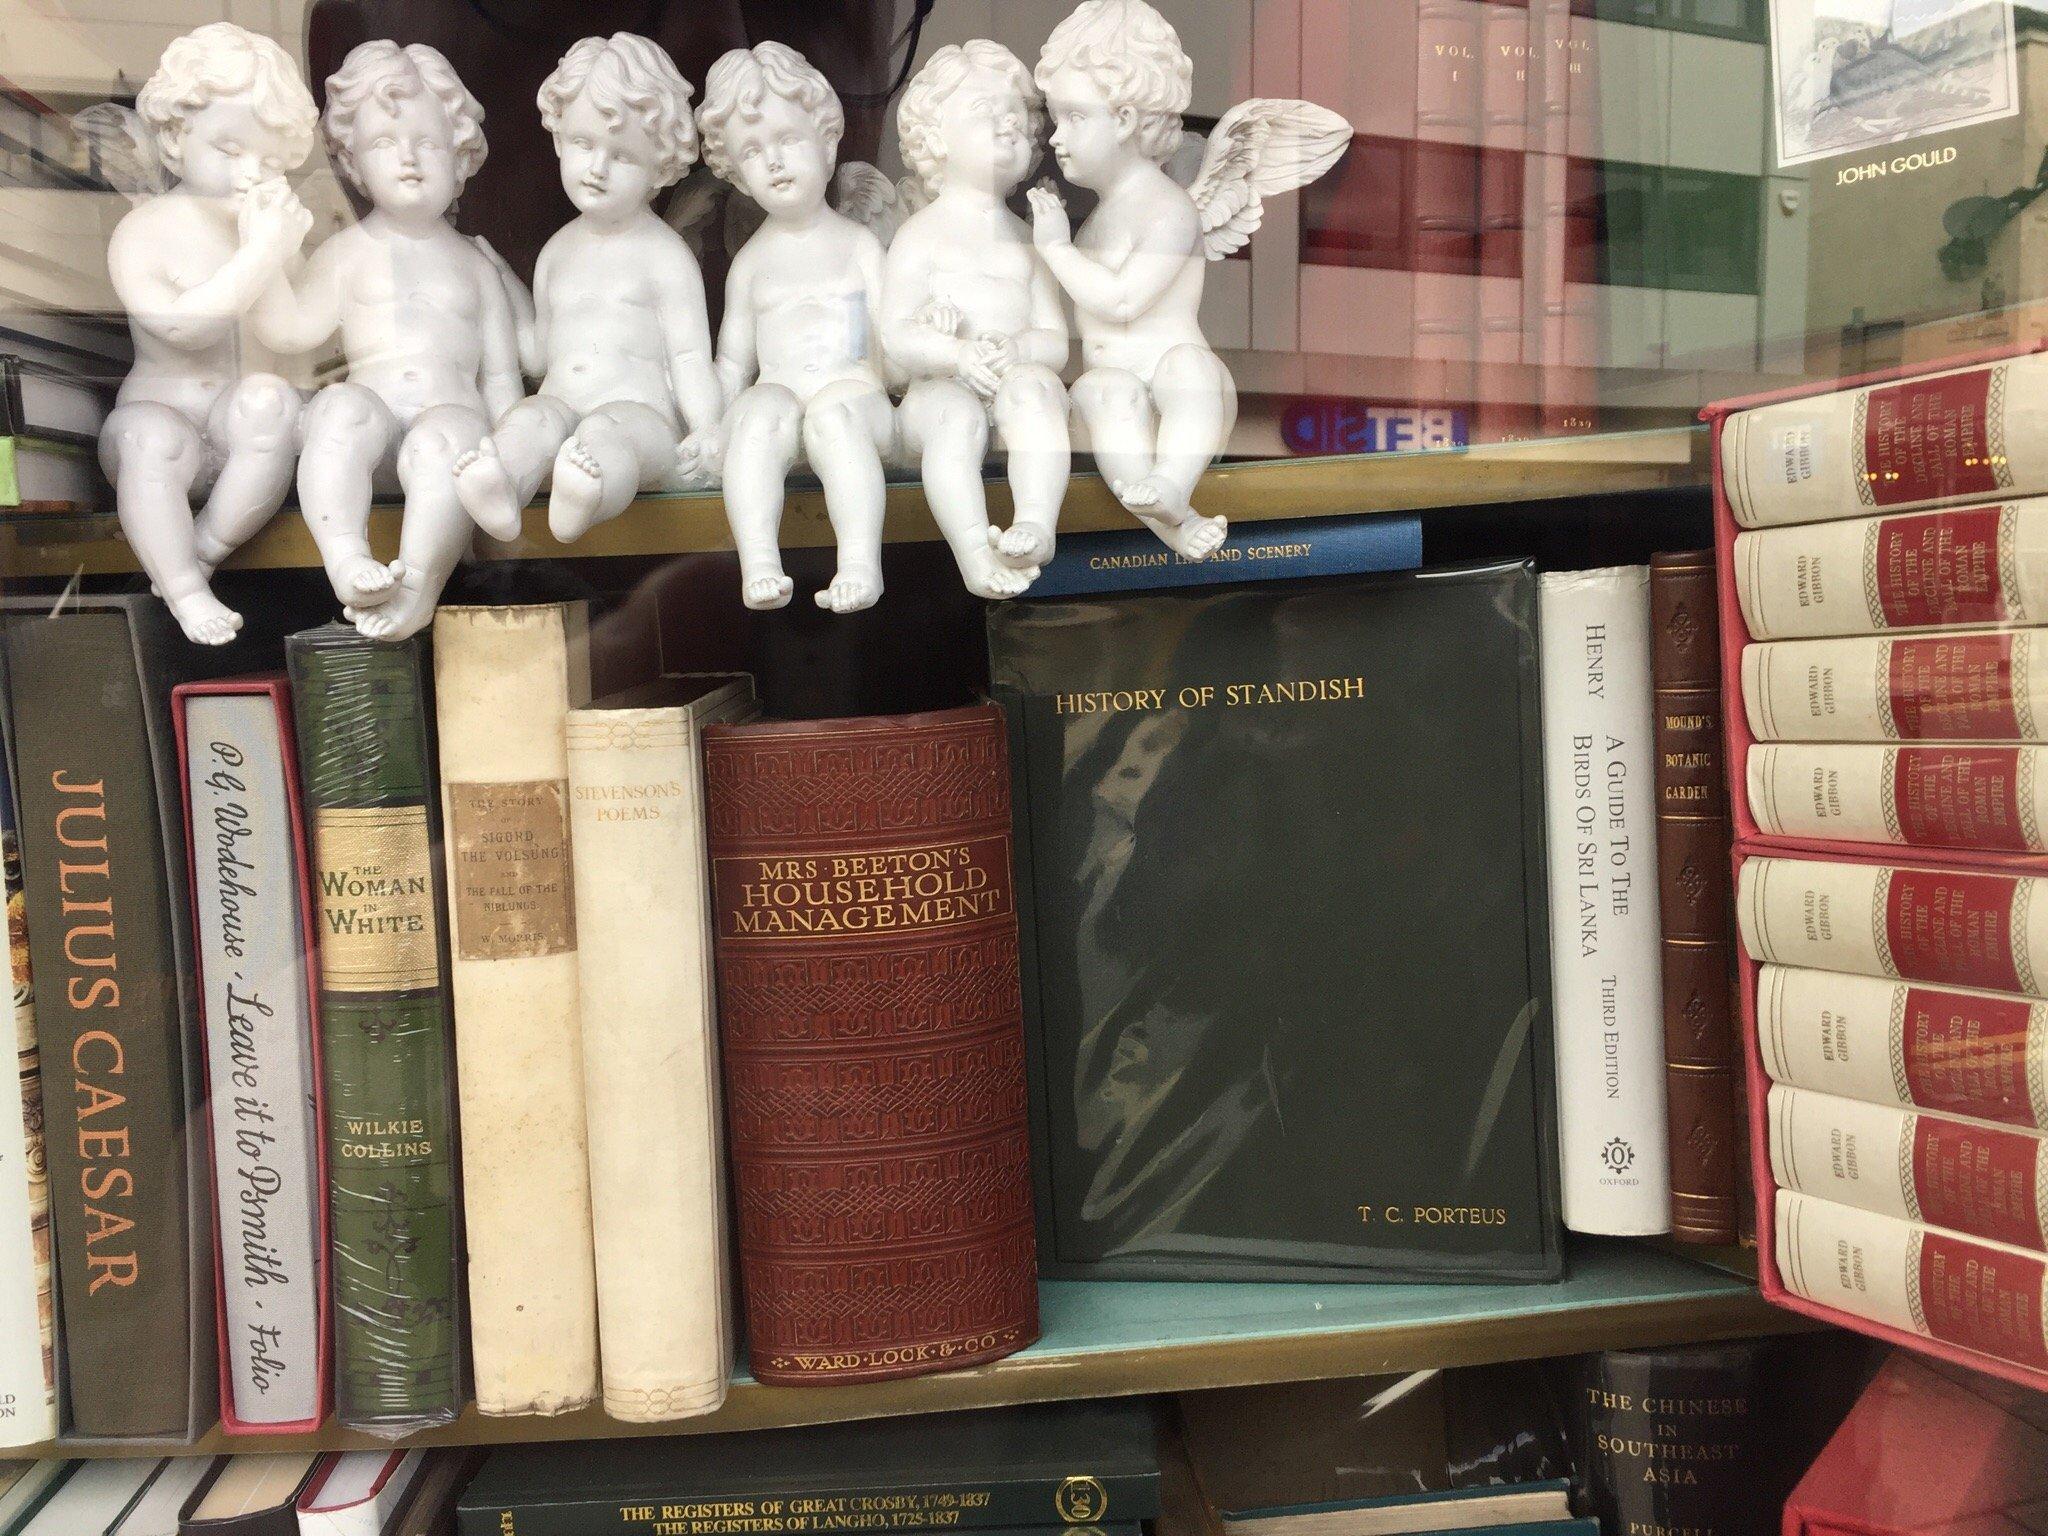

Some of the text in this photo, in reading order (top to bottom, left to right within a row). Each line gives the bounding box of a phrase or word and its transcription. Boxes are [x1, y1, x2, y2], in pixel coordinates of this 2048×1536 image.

[1836, 147, 1957, 186] JOHN GOULD
[1922, 527, 1935, 553] AND
[1940, 528, 1953, 554] THE
[1090, 554, 1168, 570] CANADIAN
[1210, 549, 1241, 562] AND
[1248, 544, 1312, 560] SCENERY
[1890, 532, 1903, 586] HISTORY
[1906, 549, 1917, 575] THE
[1940, 560, 1950, 575] OF
[1797, 555, 1810, 606] EDWARD
[1810, 556, 1824, 603] GIBBON
[1586, 624, 1605, 699] HENRY
[1936, 645, 1948, 671] AND
[1056, 678, 1365, 715] HISTORY OF STANDISH
[1809, 665, 1821, 717] EDWARD
[1824, 668, 1836, 714] GIBBON
[1665, 715, 1714, 731] MOUND'S
[1606, 735, 1626, 753] A
[1665, 753, 1711, 768] BOTANIC
[1573, 734, 1593, 799] BIRDS
[1958, 757, 1971, 784] THE
[575, 781, 682, 801] STEVENSON'S
[1606, 761, 1627, 830] GUIDE
[1665, 786, 1708, 800] GARDEN
[1813, 767, 1827, 817] EDWARD
[1828, 770, 1842, 816] GIBBON
[597, 806, 661, 822] POEMS
[353, 866, 382, 875] THE
[461, 846, 560, 863] THE VOLSUNG
[760, 847, 971, 881] MRS BEETON'S
[1577, 843, 1599, 876] SRI
[214, 803, 257, 958] Wodehouse
[320, 871, 425, 897] WOMAN
[742, 867, 988, 908] HOUSEHOLD
[1611, 873, 1631, 916] THE
[363, 903, 378, 913] IN
[732, 889, 1001, 933] MANAGEMENT
[1804, 890, 1818, 941] EDWARD
[1901, 885, 1914, 938] HISTORY
[1934, 886, 1947, 914] AND
[1951, 889, 1964, 916] THE
[325, 908, 424, 935] WHITE
[1579, 883, 1599, 958] LANKA
[1820, 894, 1834, 941] GIBBON
[52, 769, 139, 1297] JULIUS CAESAR
[226, 983, 274, 1088] Leave
[1601, 975, 1620, 1099] THIRD EDITION
[1822, 1010, 1835, 1061] EDWARD
[1836, 1015, 1850, 1062] GIBBON
[235, 1097, 275, 1122] it
[346, 1120, 424, 1135] WILKIE
[236, 1129, 276, 1162] to
[341, 1141, 433, 1158] COLLINS
[1830, 1128, 1844, 1179] EDWARD
[1846, 1134, 1860, 1180] GIBBON
[1599, 1178, 1639, 1186] OXFORD
[238, 1165, 289, 1288] Psmith
[1414, 1207, 1507, 1225] PORTEUS
[1838, 1240, 1852, 1290] EDWARD
[1852, 1247, 1867, 1292] GIBBON
[248, 1323, 287, 1395] Folio
[794, 1354, 861, 1371] WARD
[868, 1346, 931, 1366] LOCK
[1586, 1387, 1749, 1416] THE CHINESE
[1597, 1434, 1740, 1460] SOUTHEAST
[1657, 1424, 1677, 1438] IN
[1643, 1467, 1698, 1484] ASIA
[620, 1506, 656, 1521] THE
[661, 1502, 754, 1520] REGISTERS
[760, 1501, 784, 1515] OF
[789, 1497, 846, 1514] GREAT
[653, 1520, 688, 1536] THE
[691, 1517, 784, 1535] REGISTERS
[786, 1516, 810, 1530] OF
